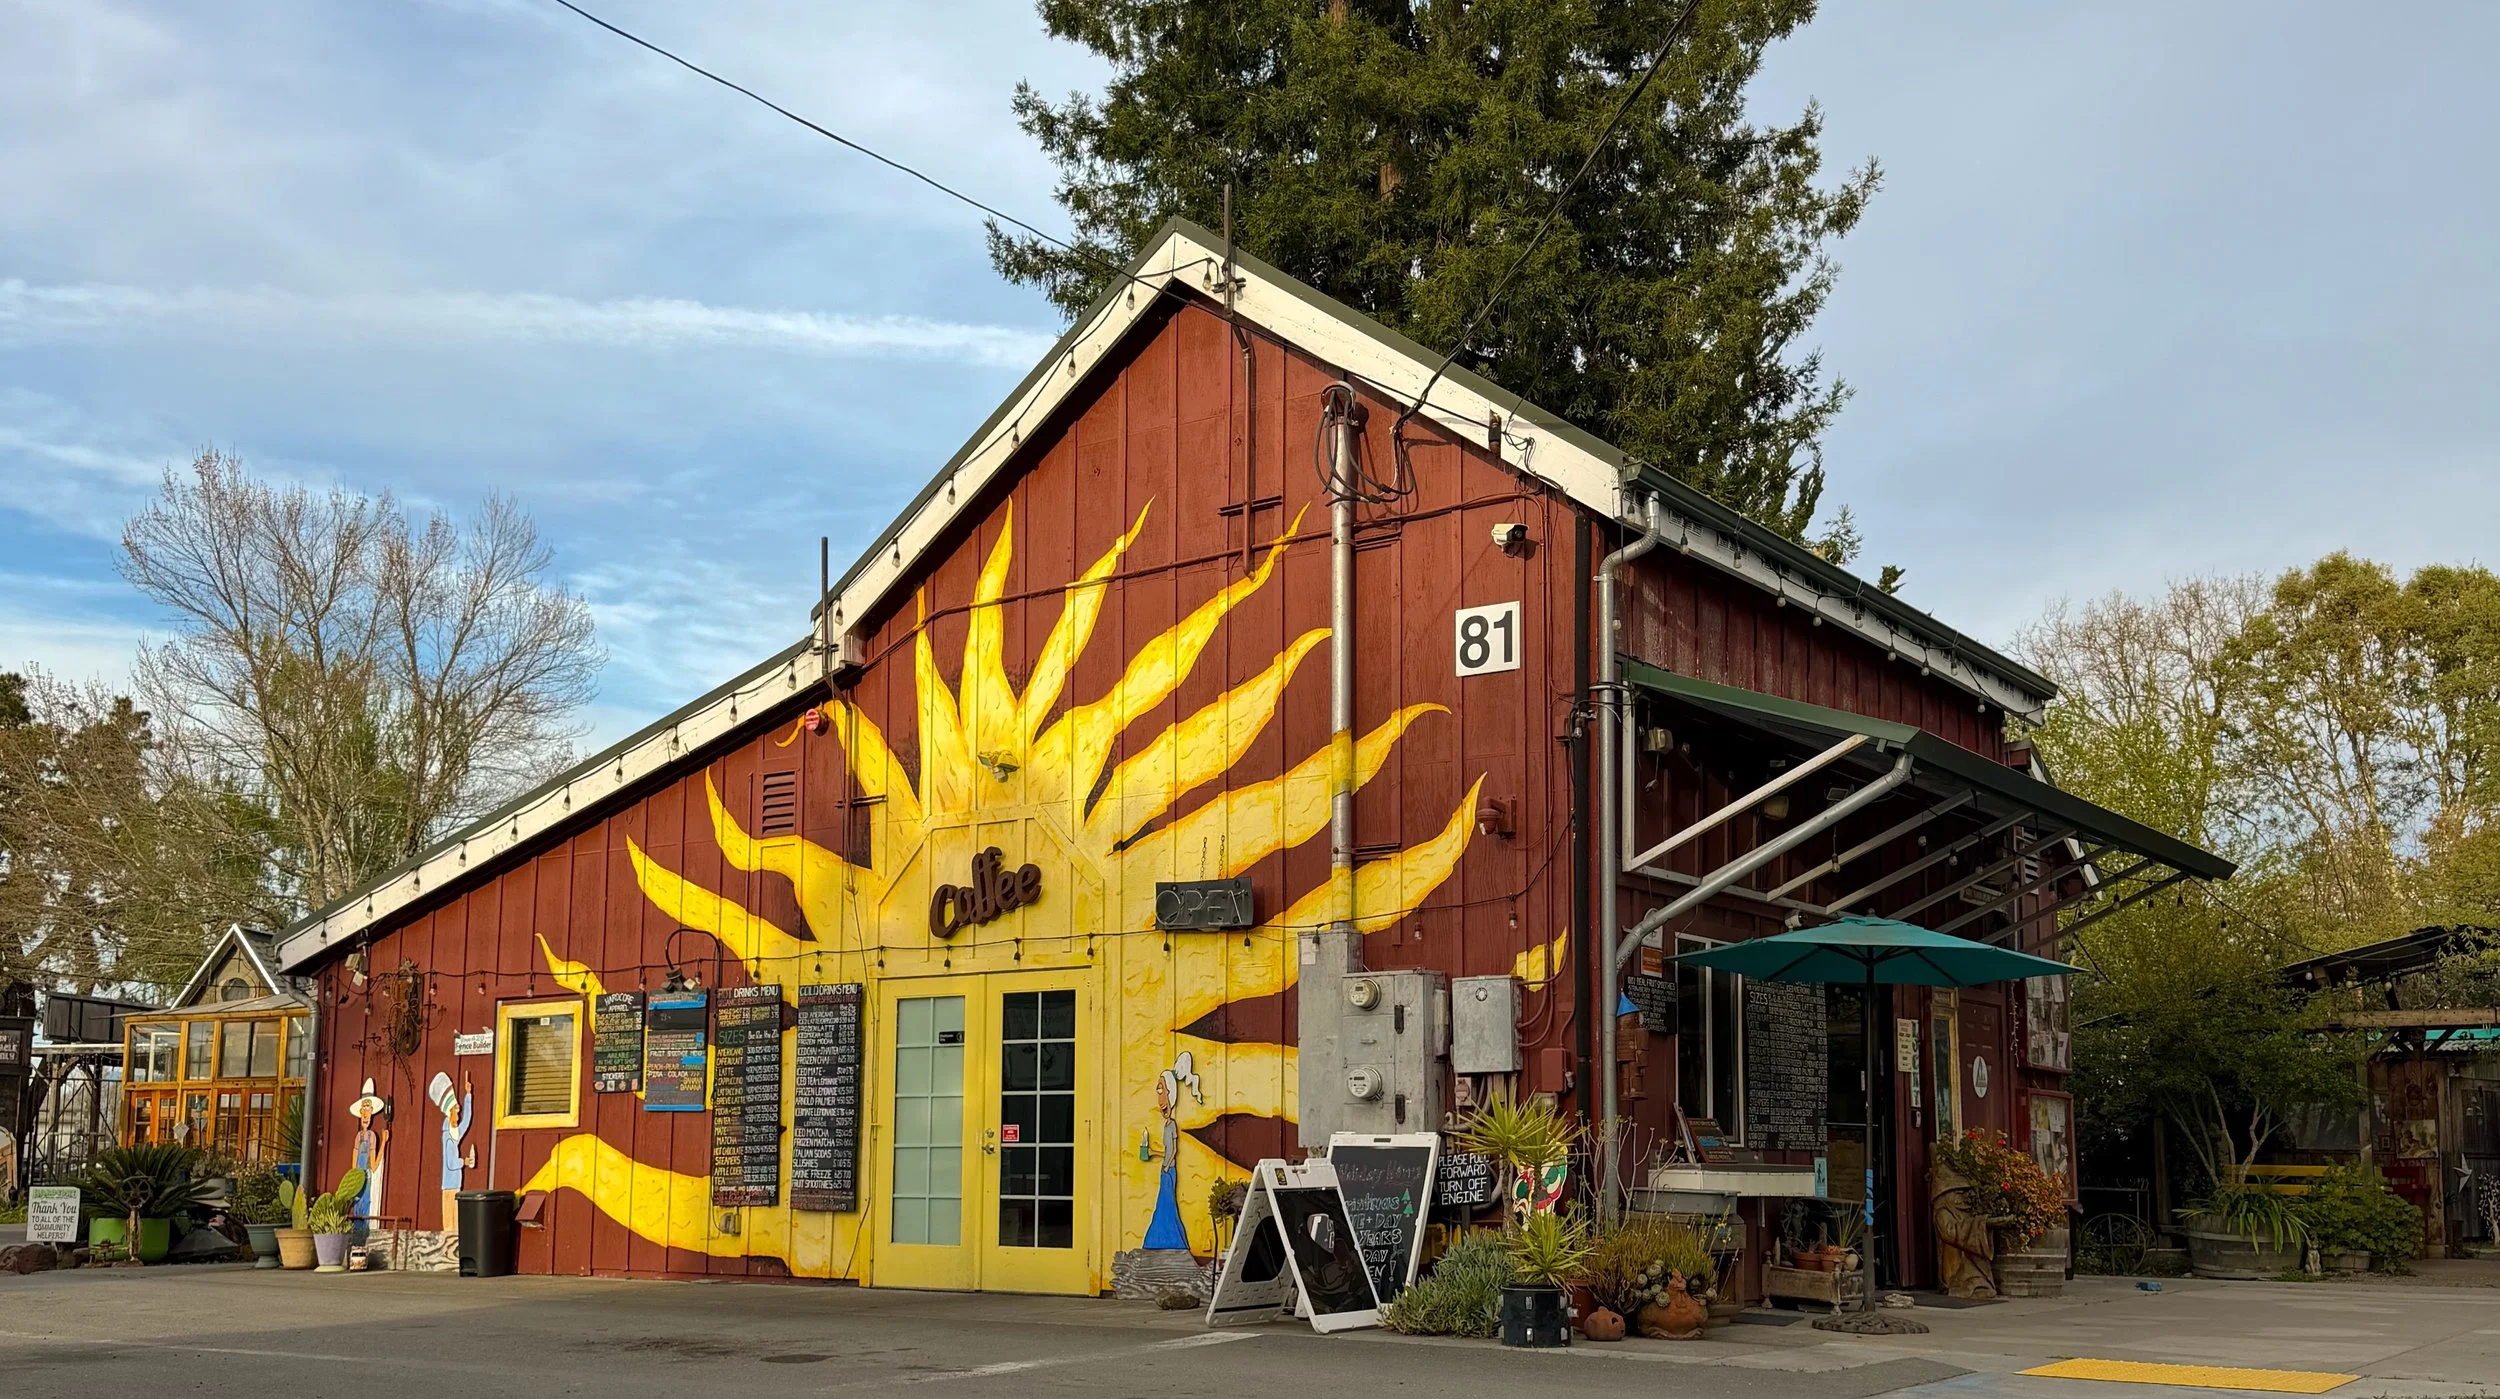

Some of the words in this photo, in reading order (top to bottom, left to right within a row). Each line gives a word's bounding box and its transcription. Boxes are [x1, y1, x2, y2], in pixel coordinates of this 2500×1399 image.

[1460, 610, 1512, 668] 81
[930, 846, 1042, 938] Coffee
[1155, 889, 1245, 926] OPEN
[733, 986, 759, 998] DRINKS
[761, 985, 779, 997] MENU
[819, 984, 841, 995] DRINKS
[843, 984, 857, 994] MENU
[604, 993, 634, 1006] HARDCORE
[1749, 991, 1768, 1005] SIZES
[718, 1030, 746, 1045] SIZES
[456, 1041, 472, 1050] Fence
[473, 1041, 491, 1049] Builder
[716, 1047, 744, 1056] AMERICANO
[797, 1056, 816, 1065] FROZEN
[718, 1067, 734, 1076] LATTE
[796, 1087, 815, 1096] FROZEN
[815, 1097, 835, 1105] PALMER
[795, 1128, 806, 1138] ICED
[806, 1128, 829, 1138] MATCHA
[794, 1138, 813, 1147] FROZEN
[813, 1138, 835, 1147] MATCHA
[793, 1149, 813, 1158] ITALIAN
[814, 1149, 832, 1158] SODAS
[715, 1155, 741, 1165] STEAMERS
[792, 1159, 818, 1168] SLUSHIES
[1438, 1153, 1468, 1168] PLEASE
[714, 1166, 729, 1176] APPLE
[810, 1170, 832, 1179] FREEZE
[1440, 1163, 1487, 1180] FORWARD
[715, 1176, 725, 1185] TEA
[792, 1180, 804, 1188] FRUIT
[804, 1180, 832, 1189] SMOOTHIES
[1439, 1180, 1463, 1193] TURN
[1467, 1177, 1487, 1190] OFF
[1345, 1192, 1400, 1212] ristmas
[1441, 1189, 1484, 1206] ENGINE
[31, 1201, 58, 1214] Thank
[60, 1201, 77, 1214] You
[32, 1215, 40, 1223] TO
[40, 1215, 51, 1223] ALL
[52, 1215, 61, 1223] OF
[62, 1215, 75, 1223] THE
[1374, 1213, 1402, 1229] DAY
[33, 1223, 71, 1231] COMMUNITY
[37, 1231, 66, 1239] HELPERS!
[1358, 1228, 1403, 1246] YEARS
[1363, 1249, 1388, 1263] DAY
